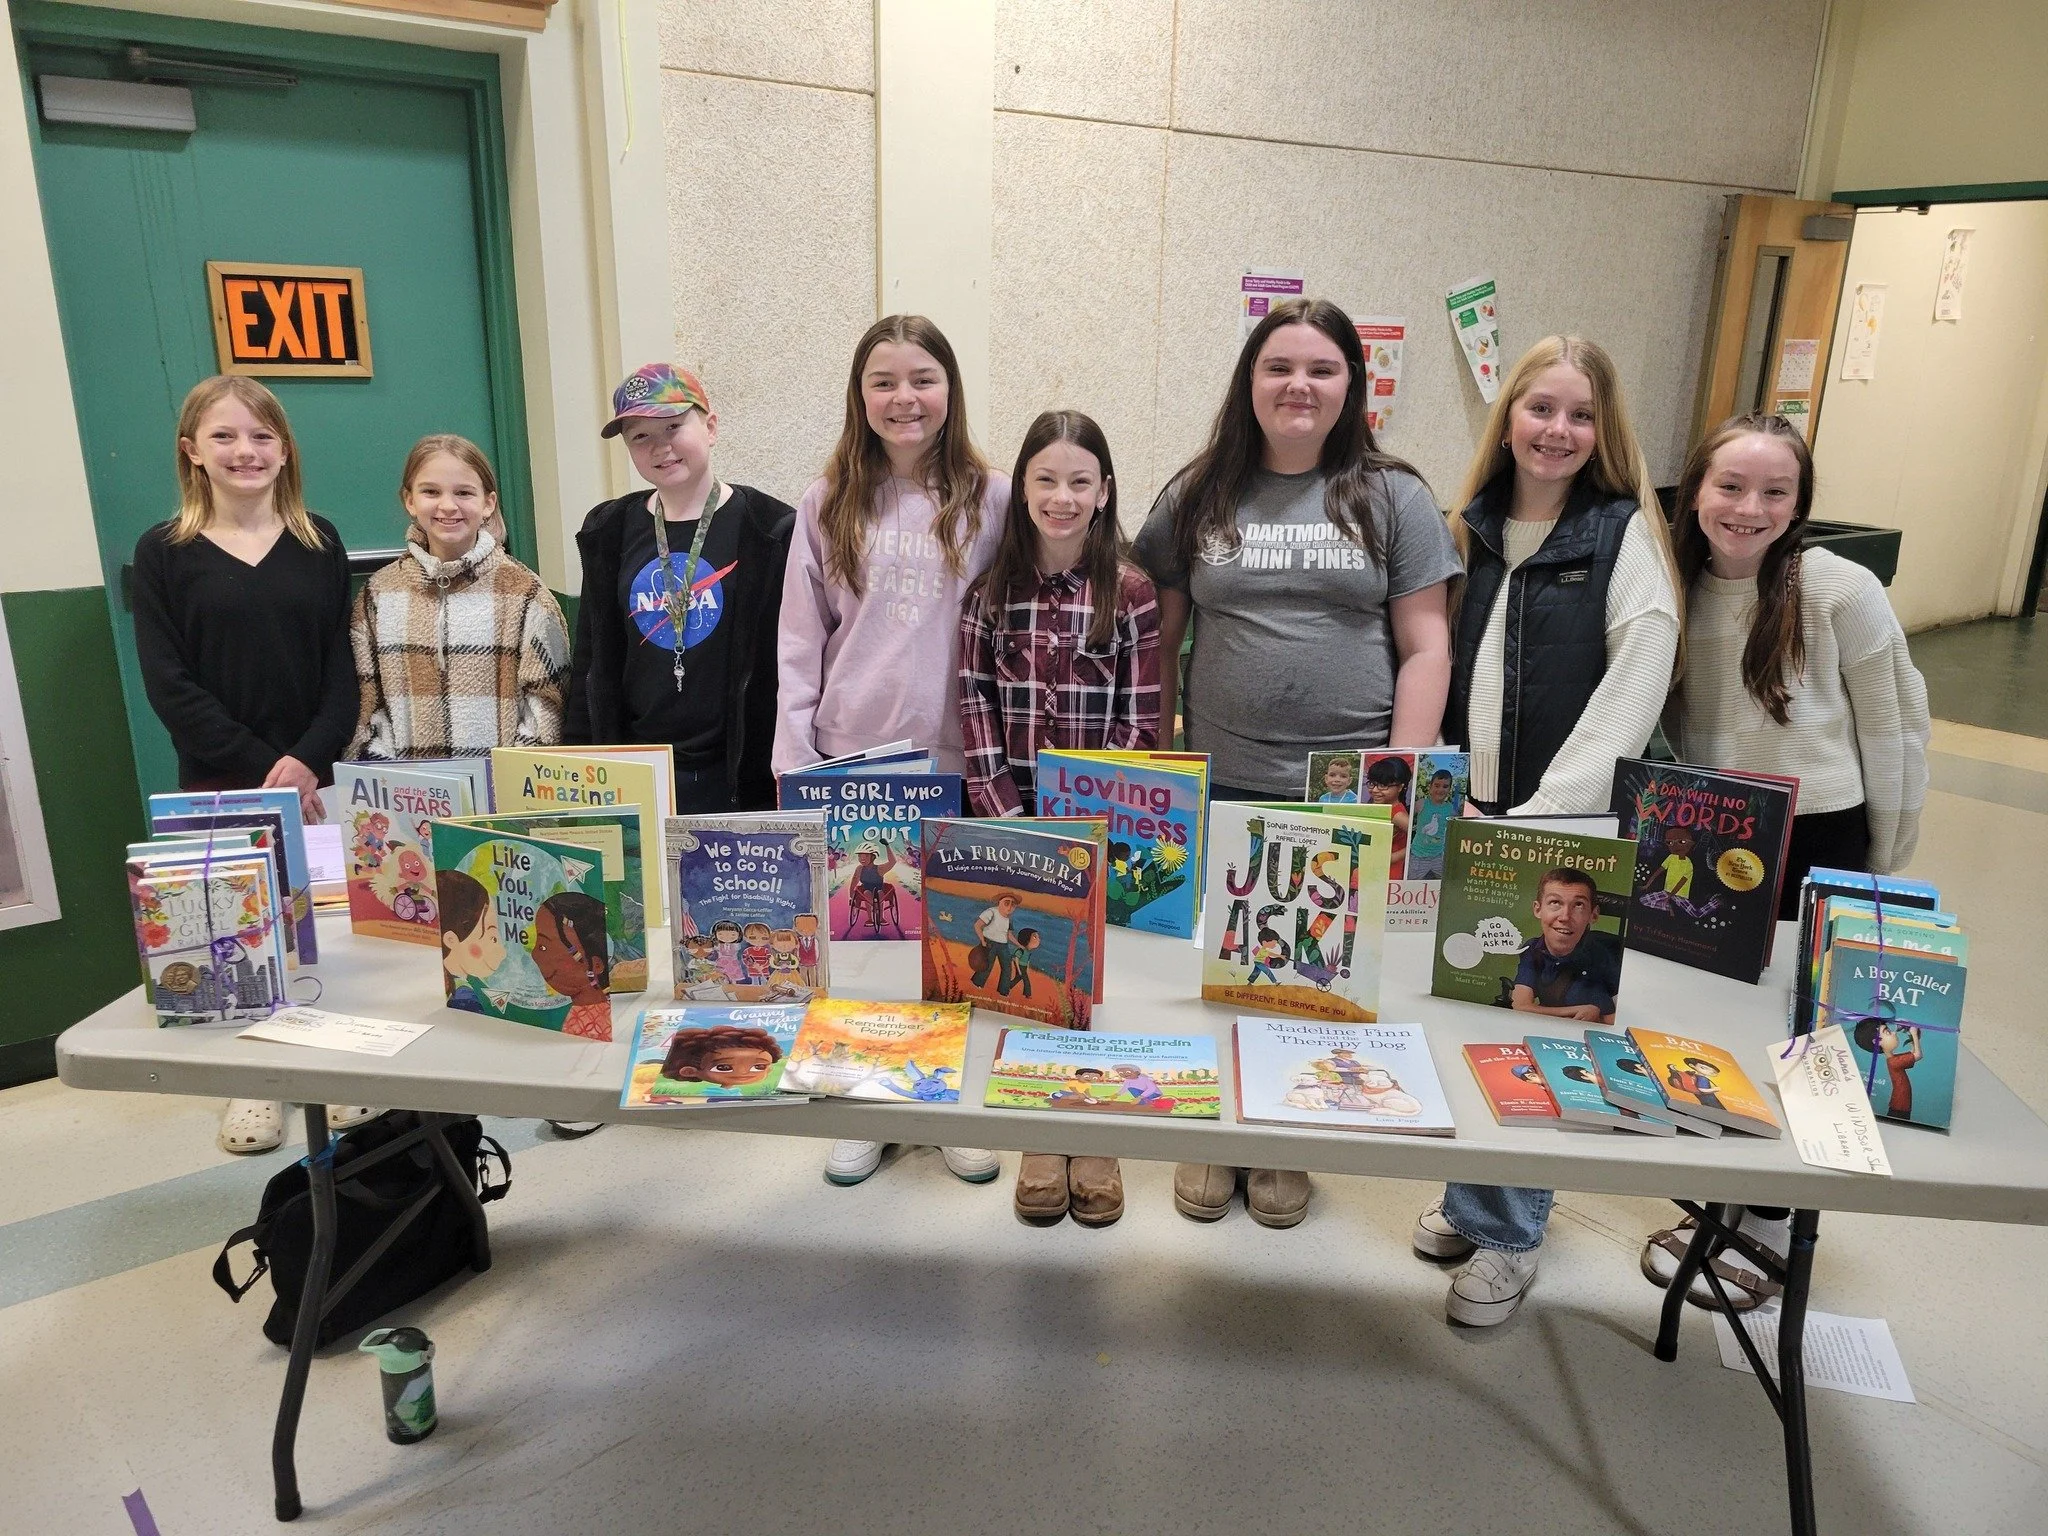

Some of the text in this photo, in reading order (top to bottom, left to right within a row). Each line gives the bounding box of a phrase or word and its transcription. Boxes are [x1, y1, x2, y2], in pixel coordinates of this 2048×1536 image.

[224, 279, 349, 359] EXIT
[1245, 523, 1363, 541] DARTMOU
[1241, 548, 1366, 570] MINI PINES
[868, 565, 945, 599] EAGLE
[534, 763, 607, 785] You're SO
[351, 776, 450, 810] Ali and the SEA
[523, 777, 622, 805] Amazing!
[799, 781, 943, 802] THE GIRL WHO
[1059, 766, 1171, 816] Loving
[1647, 780, 1747, 811] A DAY WITH NO
[393, 794, 452, 818] STARS
[822, 804, 921, 823] FIGURED
[1634, 793, 1756, 840] WORDS
[1042, 795, 1188, 845] Kindness
[831, 825, 912, 843] IT OUT
[1276, 835, 1296, 843] RAFAEL
[1496, 830, 1581, 849] Shane Burcaw
[492, 845, 531, 872] Like
[704, 840, 785, 861] We Want
[1527, 847, 1618, 873] Different
[715, 859, 778, 874] to Go to
[937, 848, 965, 864] LA
[970, 845, 1083, 888] FRONTERA
[1226, 818, 1372, 913] JUST
[1469, 867, 1517, 882] REALLY
[1474, 860, 1514, 872] What You
[493, 870, 533, 900] You,
[713, 874, 783, 894] School!
[956, 865, 969, 873] viaje
[984, 864, 999, 873] papá
[1006, 867, 1015, 876] My
[1016, 869, 1042, 882] Journey
[1043, 875, 1057, 885] with
[1057, 880, 1073, 892] Papa
[1466, 878, 1518, 891] Want to Ask
[1387, 882, 1441, 908] Body
[1463, 885, 1489, 895] About
[169, 894, 235, 917] LUCKY
[496, 896, 534, 922] Like
[699, 898, 712, 907] The
[712, 894, 729, 903] Fight
[743, 893, 774, 903] Disability
[776, 898, 796, 910] Rights
[179, 919, 231, 937] GIRL
[505, 922, 529, 946] Me
[1219, 899, 1358, 979] ASK!
[1483, 939, 1500, 947] Ask
[1853, 965, 1951, 996] A Boy Called
[1225, 990, 1346, 1016] BE DIFFERENT, BE BRAVE, BE YOU
[1878, 984, 1925, 1007] BAT
[729, 1009, 785, 1021] Granny
[844, 1018, 926, 1031] Remember,
[876, 1014, 896, 1022] I'll
[774, 1022, 797, 1033] My
[860, 1027, 906, 1037] Poppy
[1265, 1023, 1412, 1037] Madeline Finn
[1022, 1031, 1106, 1045] Trabajando
[1130, 1037, 1144, 1046] el
[1147, 1037, 1192, 1048] jardín
[1056, 1042, 1085, 1050] con
[1104, 1044, 1154, 1054] abuela
[1276, 1035, 1407, 1051] Therapy Dog
[1552, 1043, 1578, 1052] Boy
[1665, 1036, 1703, 1051] BAT
[1499, 1047, 1527, 1056] BA
[1566, 1051, 1591, 1061] BA
[1801, 1055, 1819, 1097] OUNDATION
[1809, 1044, 1839, 1097] BOOKS
